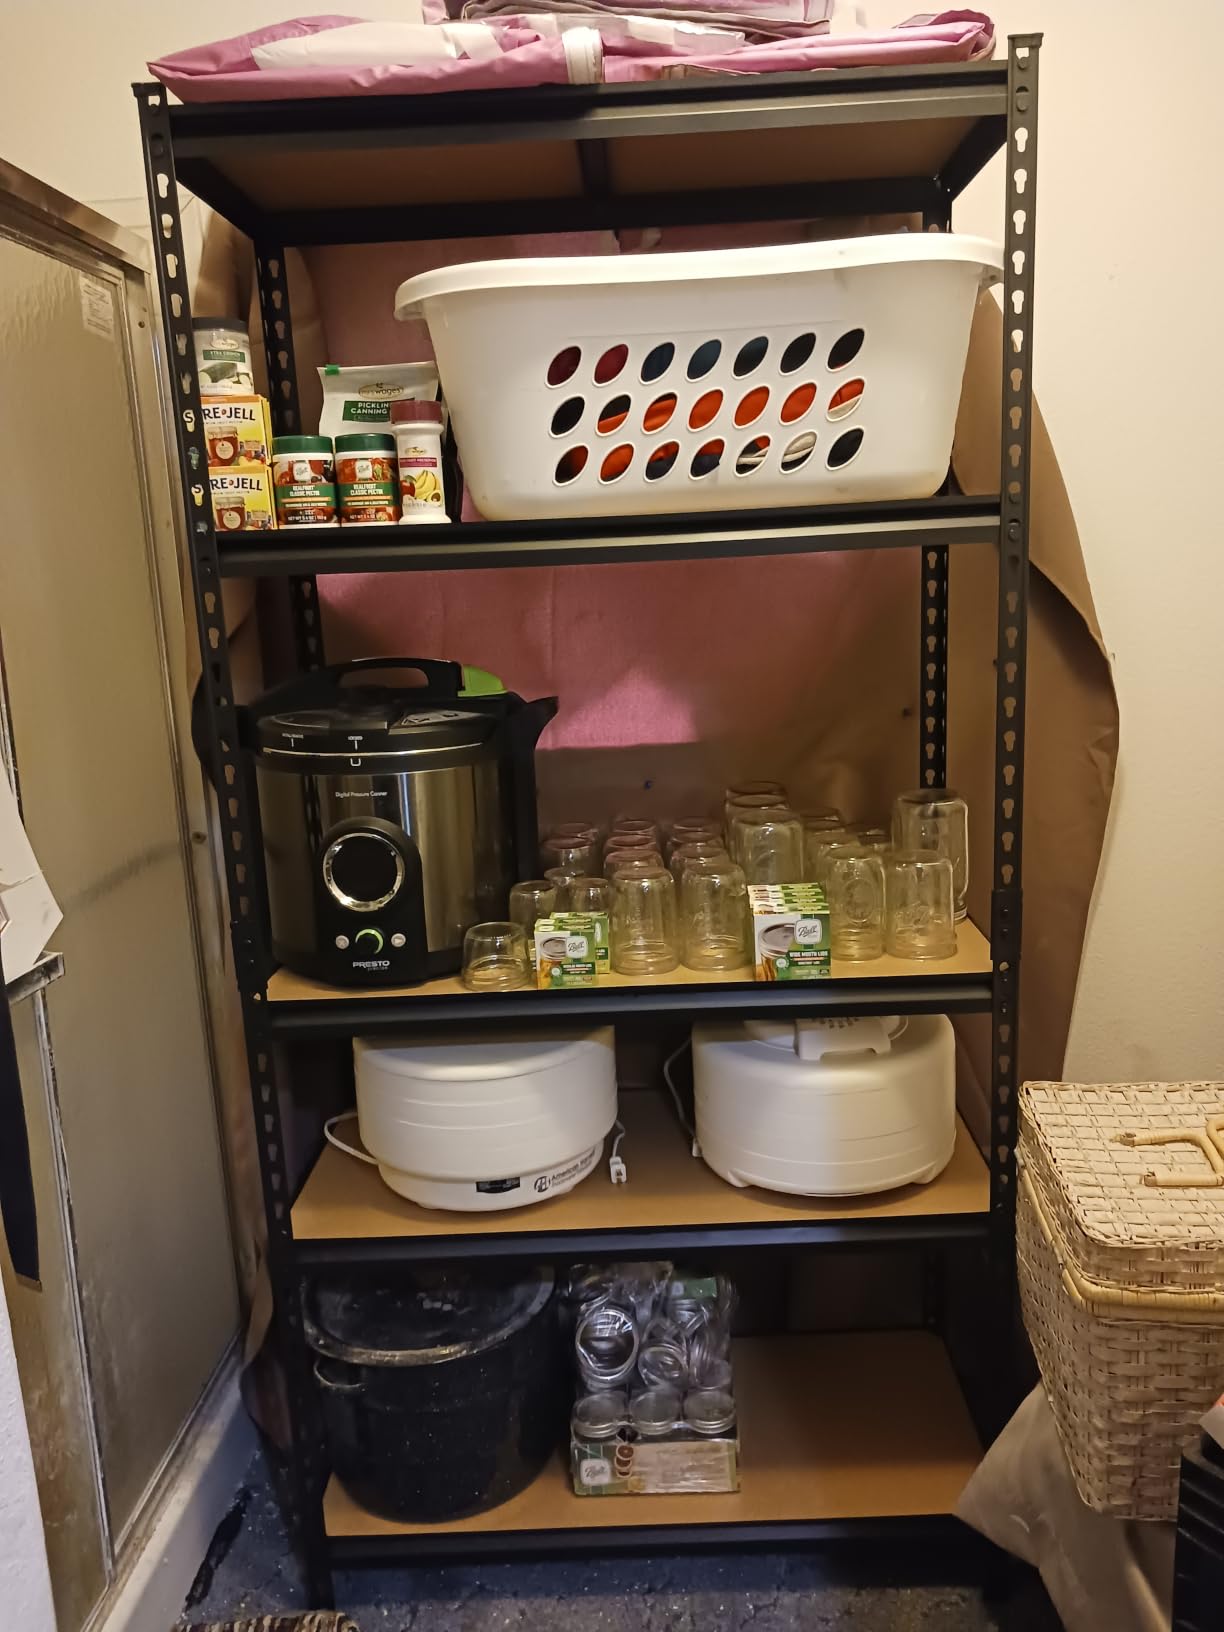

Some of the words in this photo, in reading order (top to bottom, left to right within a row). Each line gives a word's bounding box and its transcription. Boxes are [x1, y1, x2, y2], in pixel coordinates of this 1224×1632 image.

[350, 407, 388, 415] CANNING
[797, 925, 818, 938] Ball
[567, 941, 585, 953] Ball
[352, 960, 391, 969] PRESTO
